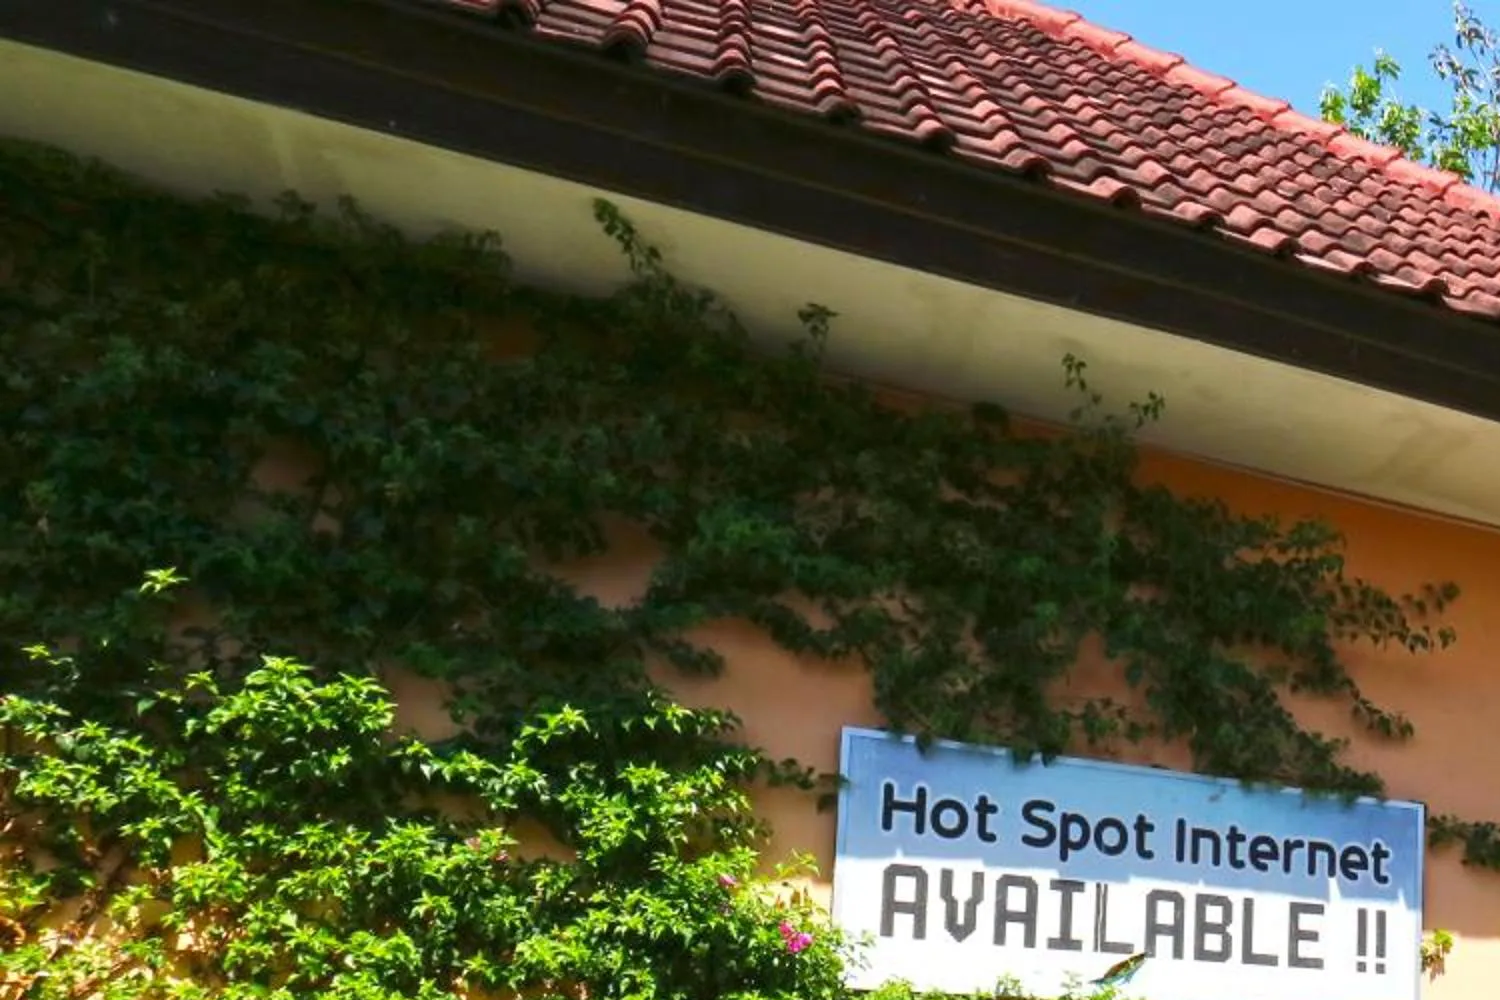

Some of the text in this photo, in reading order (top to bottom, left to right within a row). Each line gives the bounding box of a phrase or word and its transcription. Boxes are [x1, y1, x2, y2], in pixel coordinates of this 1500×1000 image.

[881, 782, 1390, 884] Hot Spot Internet
[880, 863, 1325, 969] AVAILABLE
